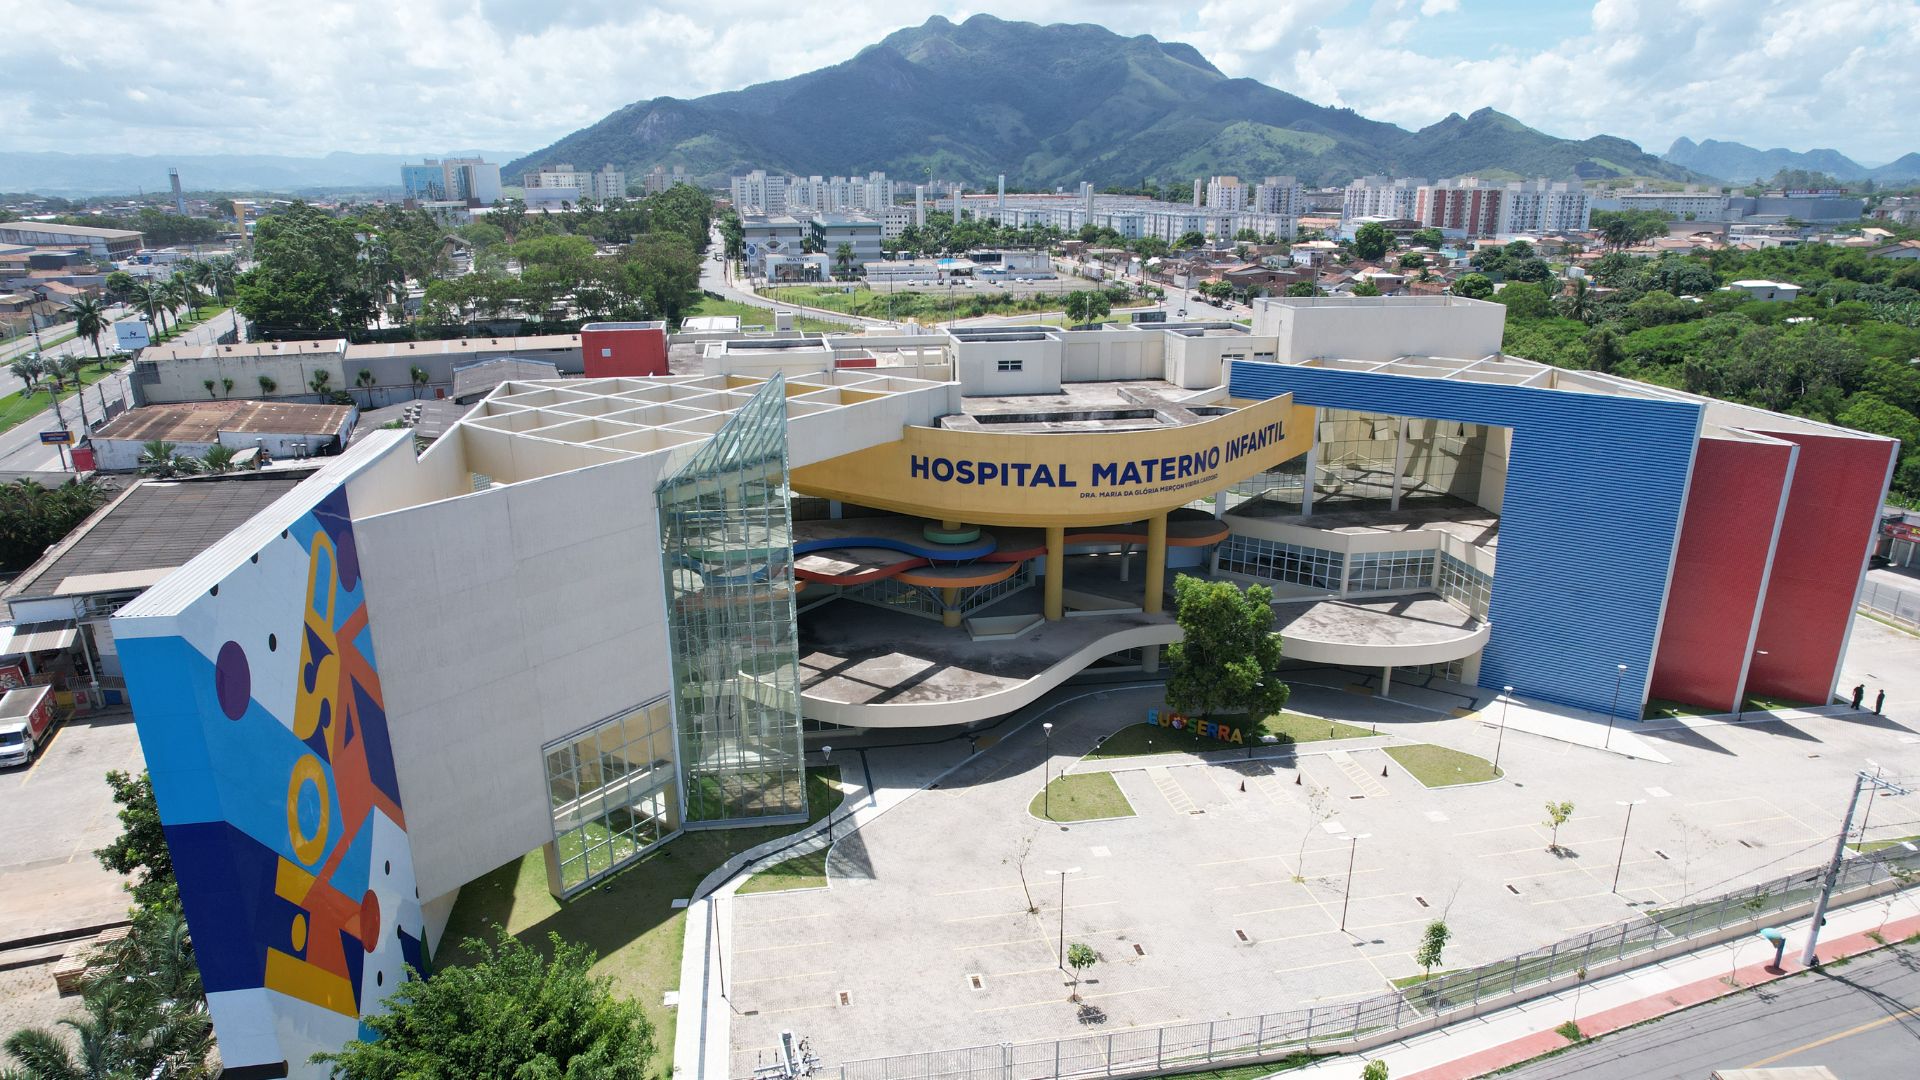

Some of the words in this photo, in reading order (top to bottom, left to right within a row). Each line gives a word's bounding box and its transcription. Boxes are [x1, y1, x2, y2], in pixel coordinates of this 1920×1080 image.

[911, 455, 1077, 487] HOSPITAL
[1092, 446, 1220, 487] MATERNO
[1225, 420, 1285, 463] INFANTIL
[1134, 487, 1159, 496] GLÓRIA
[1160, 483, 1185, 493] MERÇON
[1147, 707, 1170, 728] EU
[1186, 717, 1244, 745] SERRA
